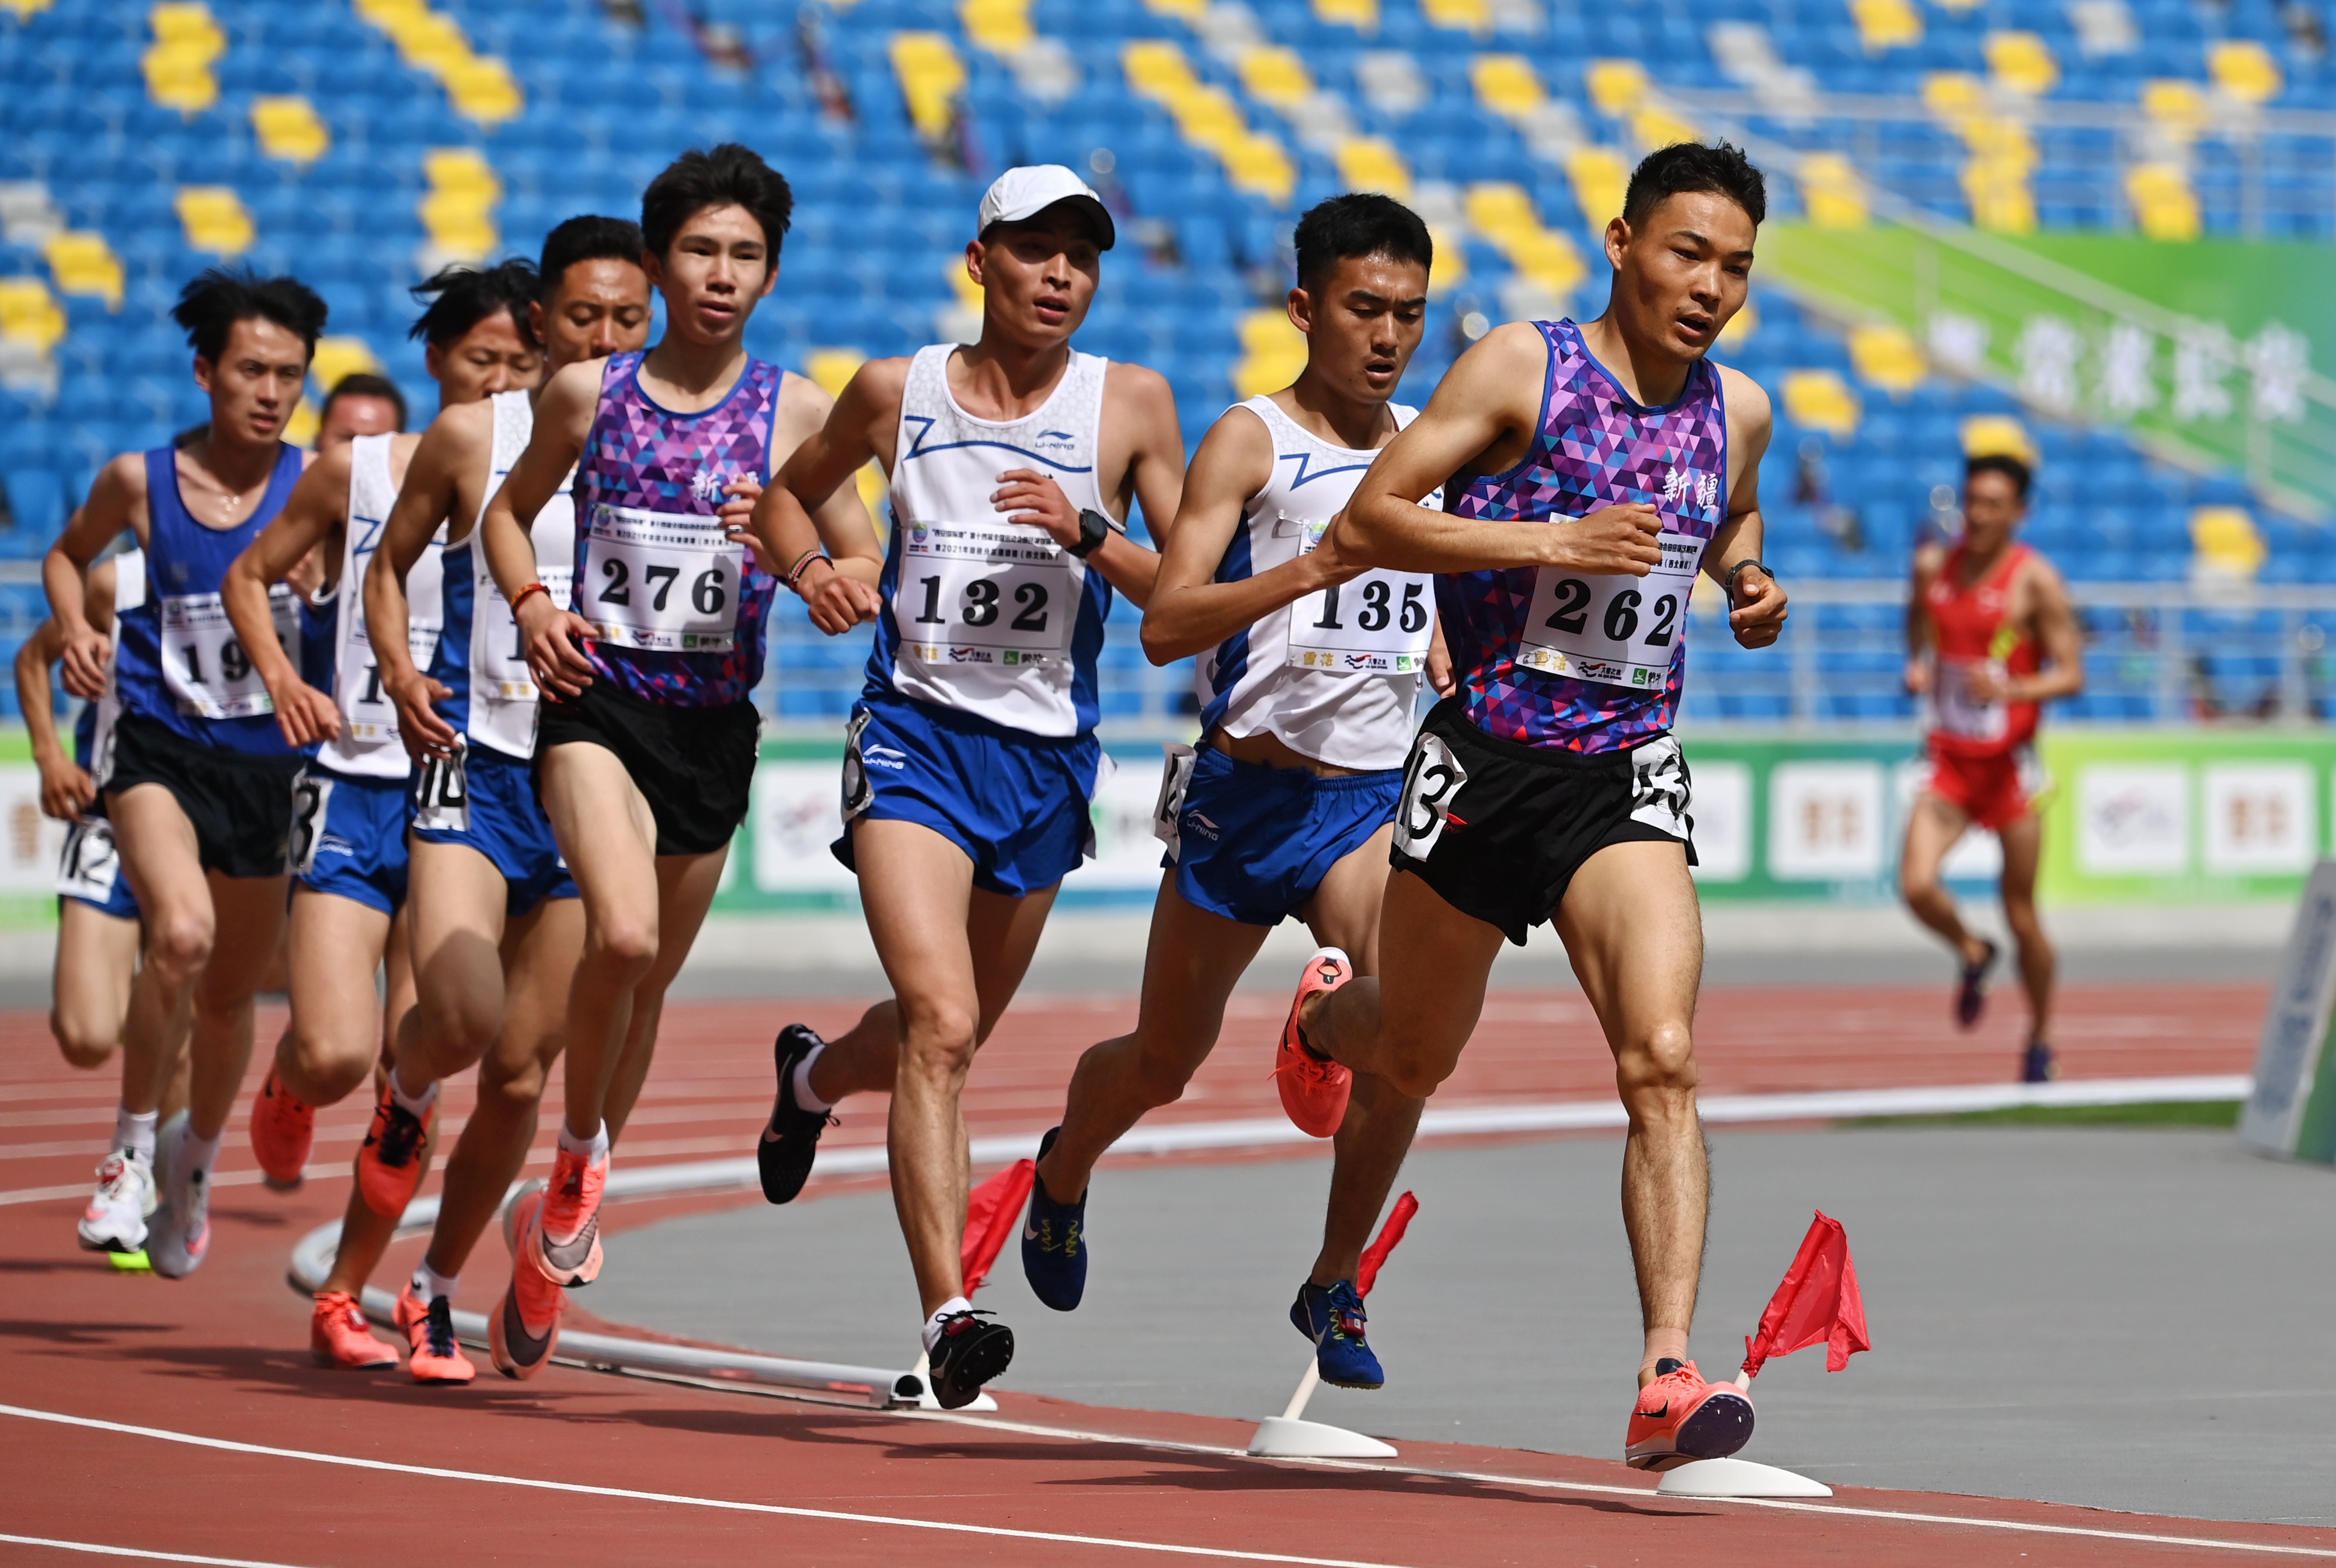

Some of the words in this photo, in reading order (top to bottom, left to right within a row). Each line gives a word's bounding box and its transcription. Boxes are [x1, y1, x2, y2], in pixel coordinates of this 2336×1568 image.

[1035, 442, 1075, 451] LI-NING
[1662, 467, 1718, 510] 新疆
[598, 559, 725, 615] 276
[915, 575, 1049, 632] 132
[1313, 580, 1428, 633] 135
[1545, 579, 1677, 647] 262
[862, 757, 904, 770] LI-NING
[1399, 750, 1456, 840] 13
[1186, 819, 1219, 841] LI-NING
